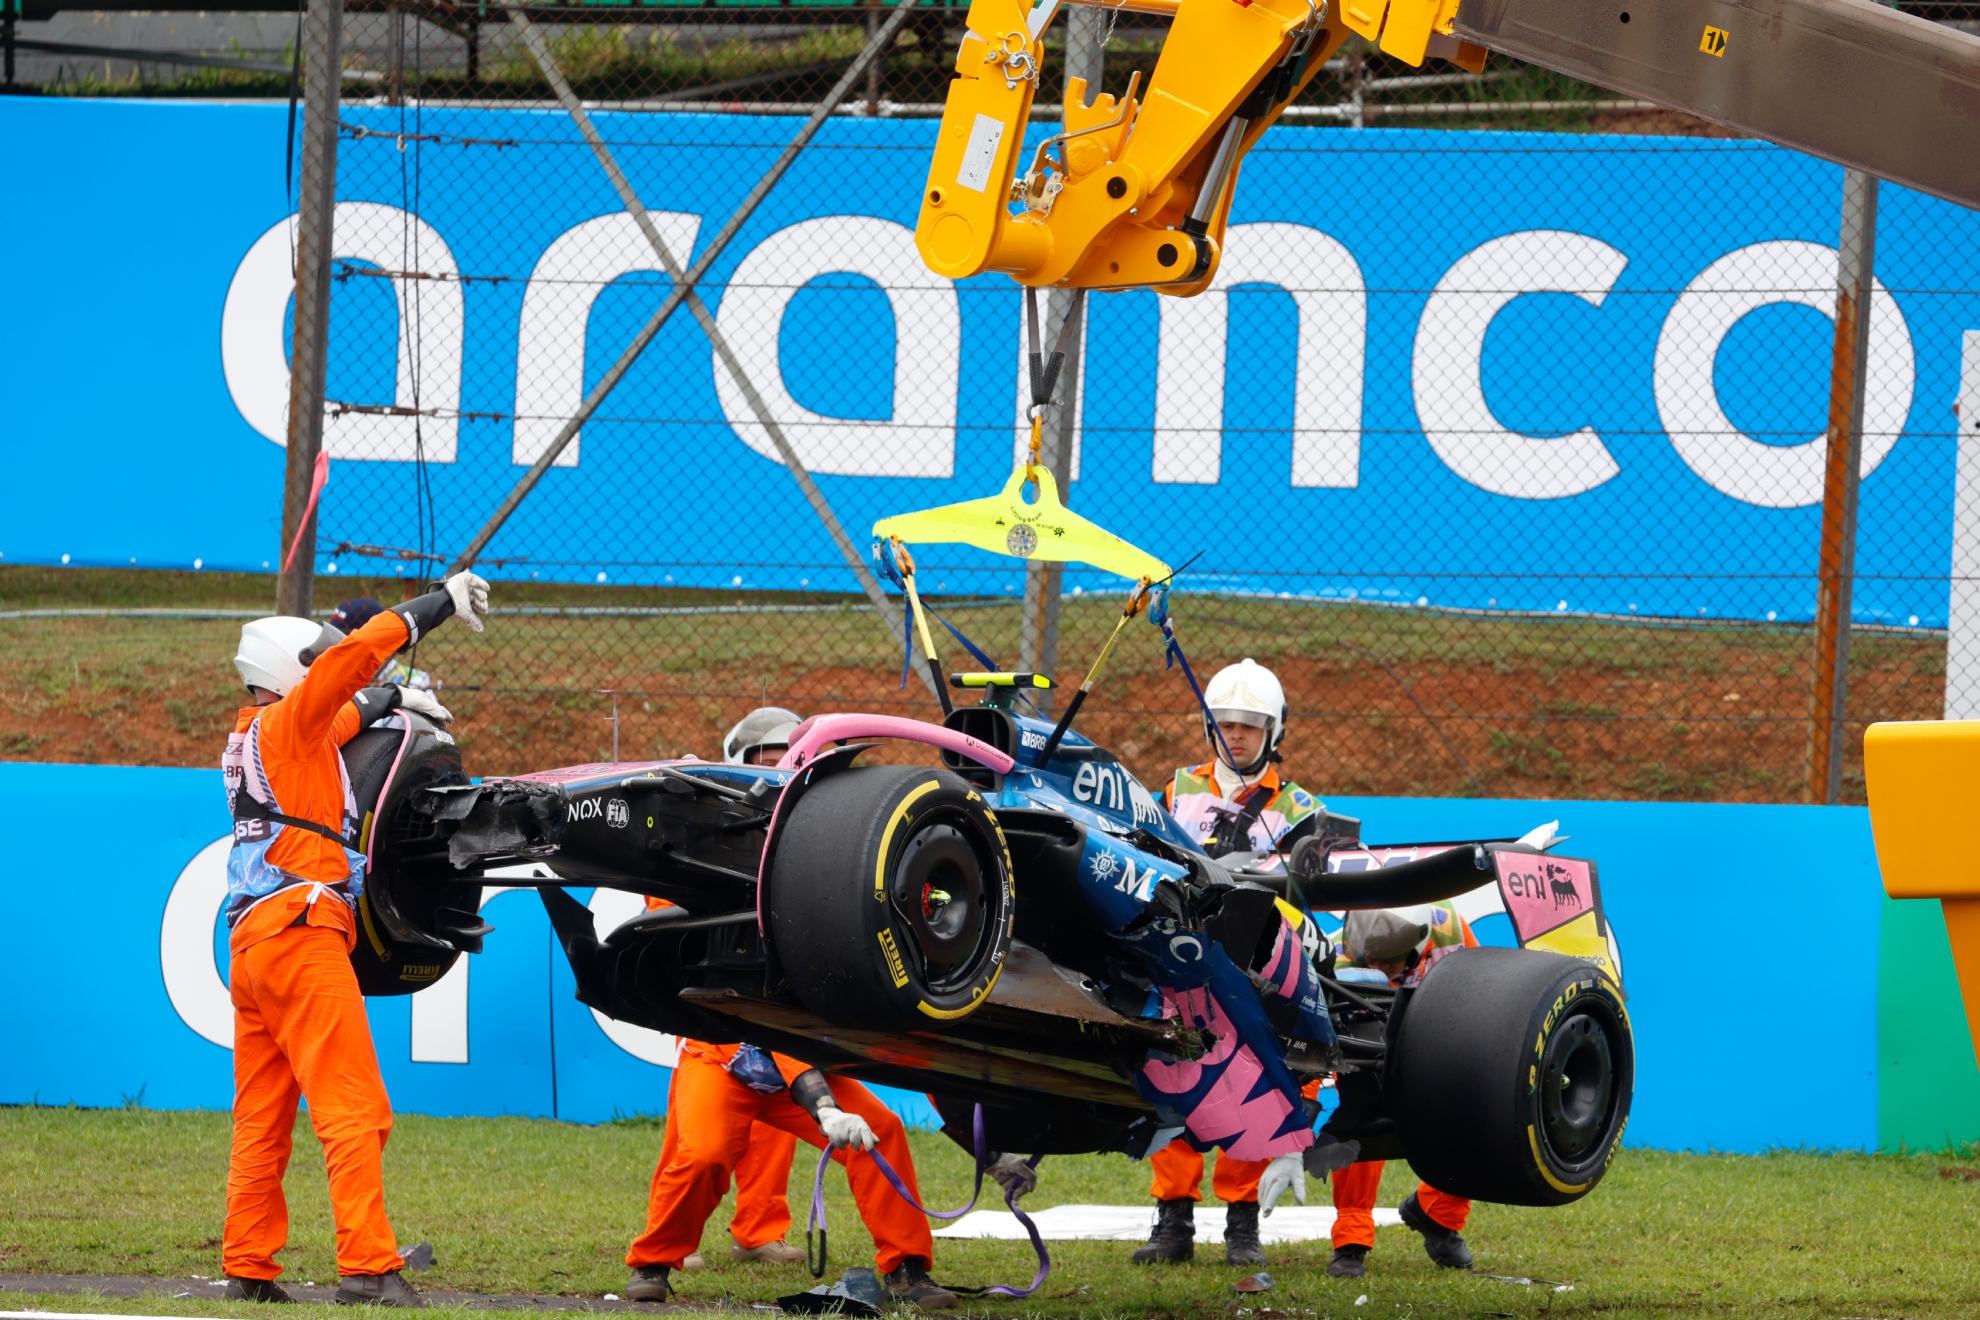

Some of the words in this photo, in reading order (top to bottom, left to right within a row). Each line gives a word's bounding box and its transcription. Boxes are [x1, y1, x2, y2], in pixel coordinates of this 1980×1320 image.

[221, 201, 1916, 507] aramco
[1027, 512, 1042, 522] Beam
[1072, 762, 1124, 811] eni
[1508, 866, 1547, 900] eni
[399, 964, 440, 982] PIRELLI
[878, 928, 908, 988] PIRELLI
[1534, 981, 1578, 1061] ZERO
